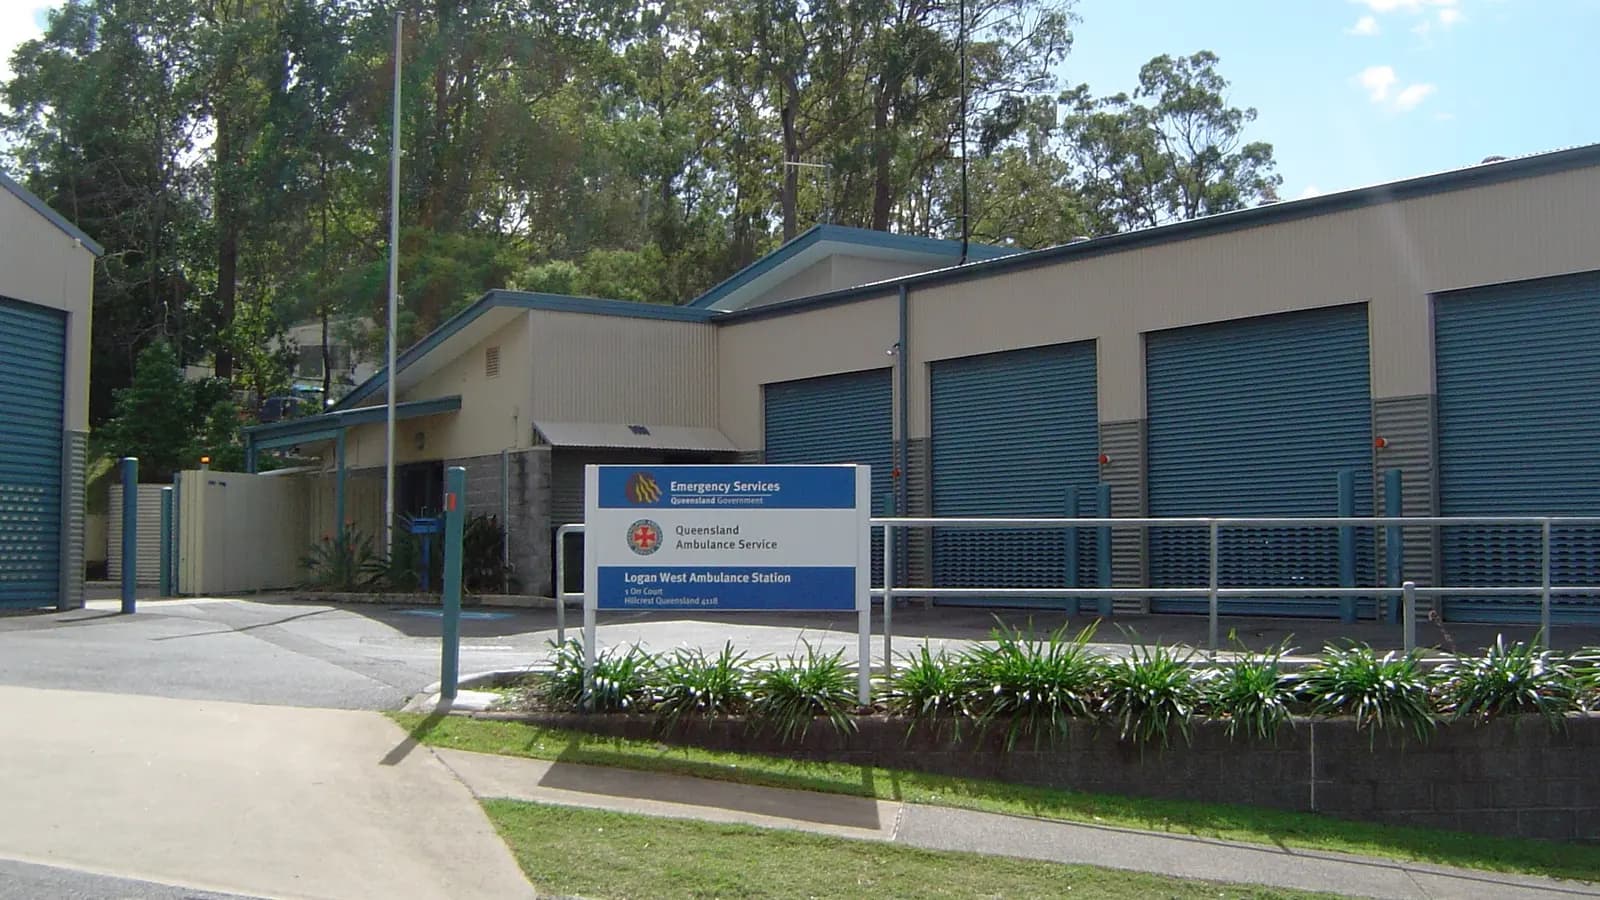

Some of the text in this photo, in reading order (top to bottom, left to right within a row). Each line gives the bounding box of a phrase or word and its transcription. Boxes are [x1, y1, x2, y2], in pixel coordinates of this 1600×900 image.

[671, 481, 780, 493] Emergency Services
[671, 496, 763, 505] Queensland Government
[676, 525, 739, 536] Queensland
[676, 540, 778, 550] Ambulance Service
[624, 572, 791, 585] Logan West Ambulance Station
[643, 587, 664, 596] Court
[624, 597, 654, 605] Hillcrest
[656, 597, 700, 606] Queensland
